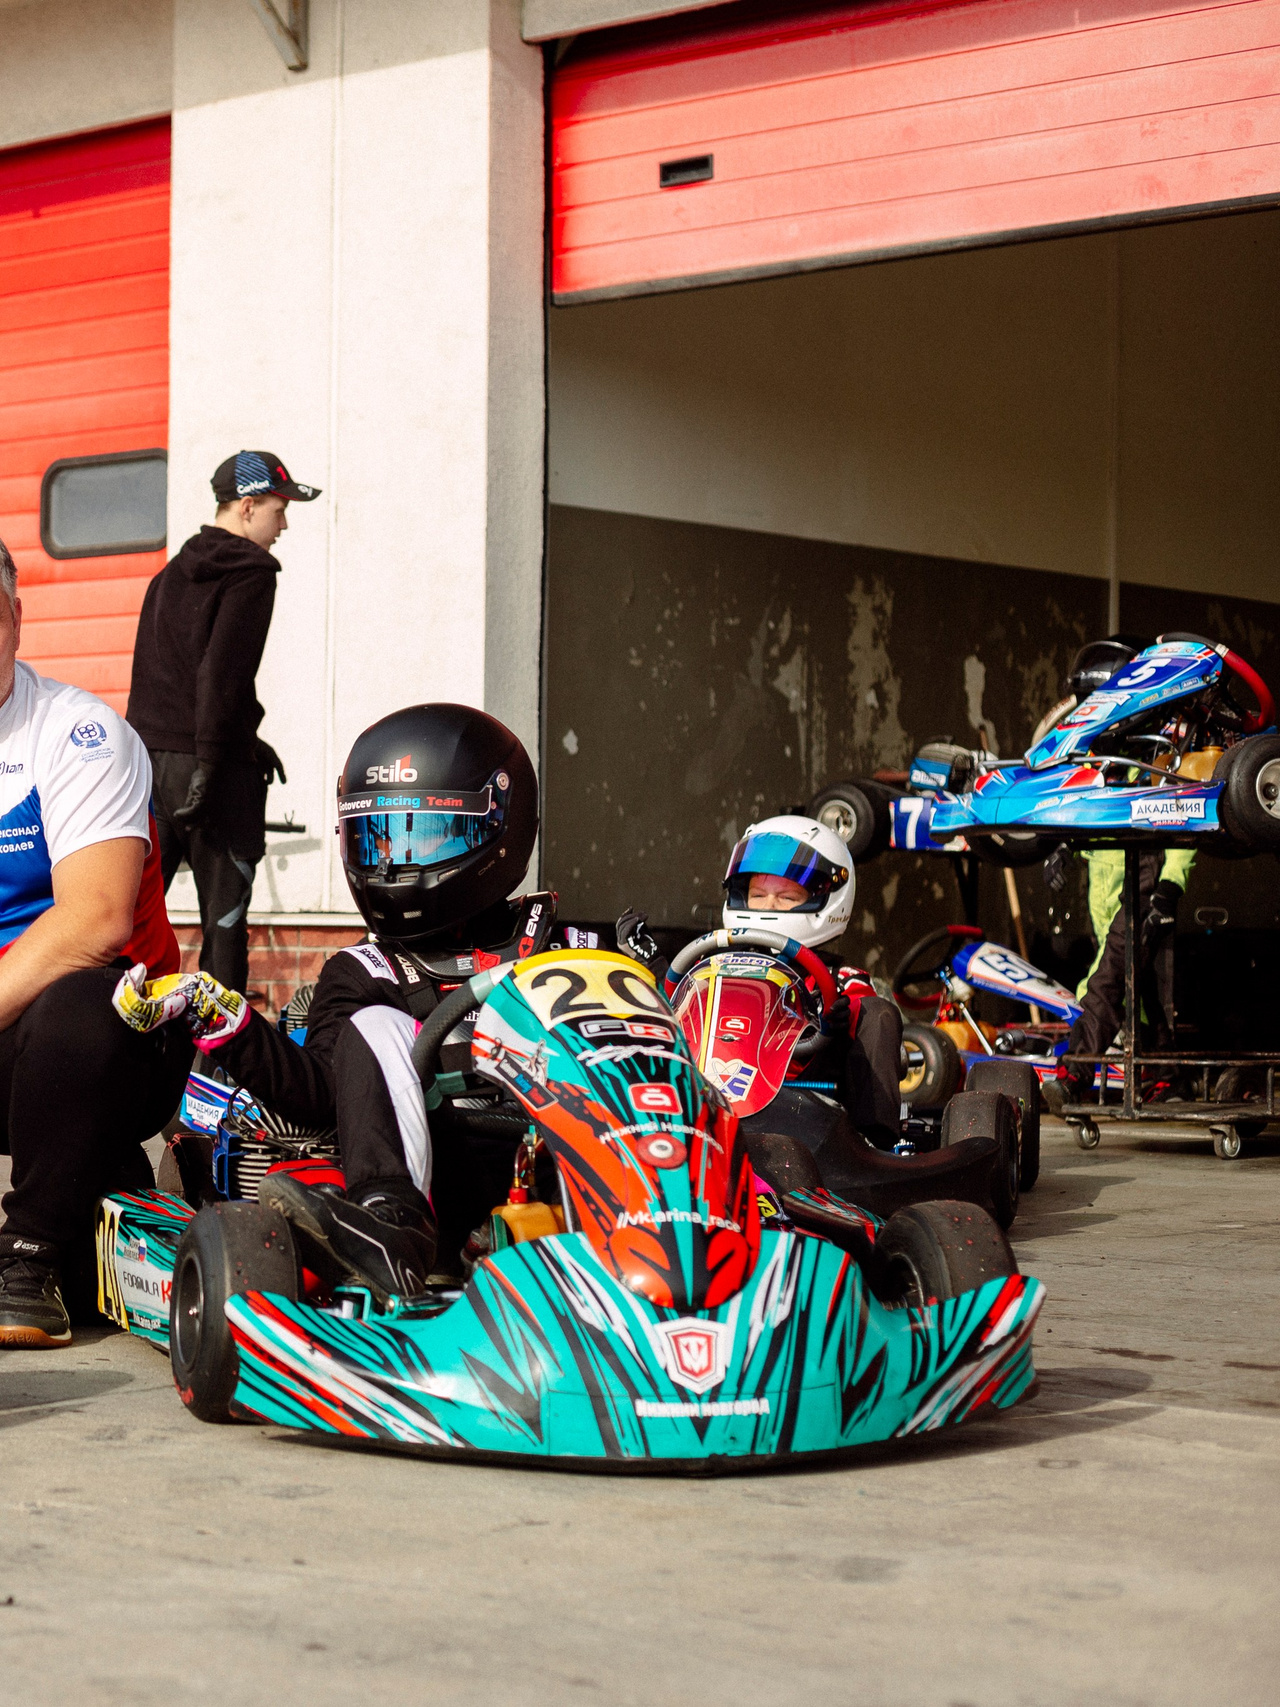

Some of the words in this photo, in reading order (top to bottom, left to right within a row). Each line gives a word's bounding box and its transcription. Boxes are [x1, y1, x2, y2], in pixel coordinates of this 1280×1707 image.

[1117, 658, 1172, 687] 5
[366, 754, 418, 785] Stilo
[338, 798, 373, 812] Gotovcev
[376, 796, 420, 809] Racing
[426, 796, 464, 807] Team
[1136, 802, 1201, 815] АКАДЕМИЯ
[531, 968, 667, 1021] 20
[599, 1121, 659, 1145] Нижний
[21, 1242, 40, 1252] asics
[122, 1270, 160, 1298] FORMULA
